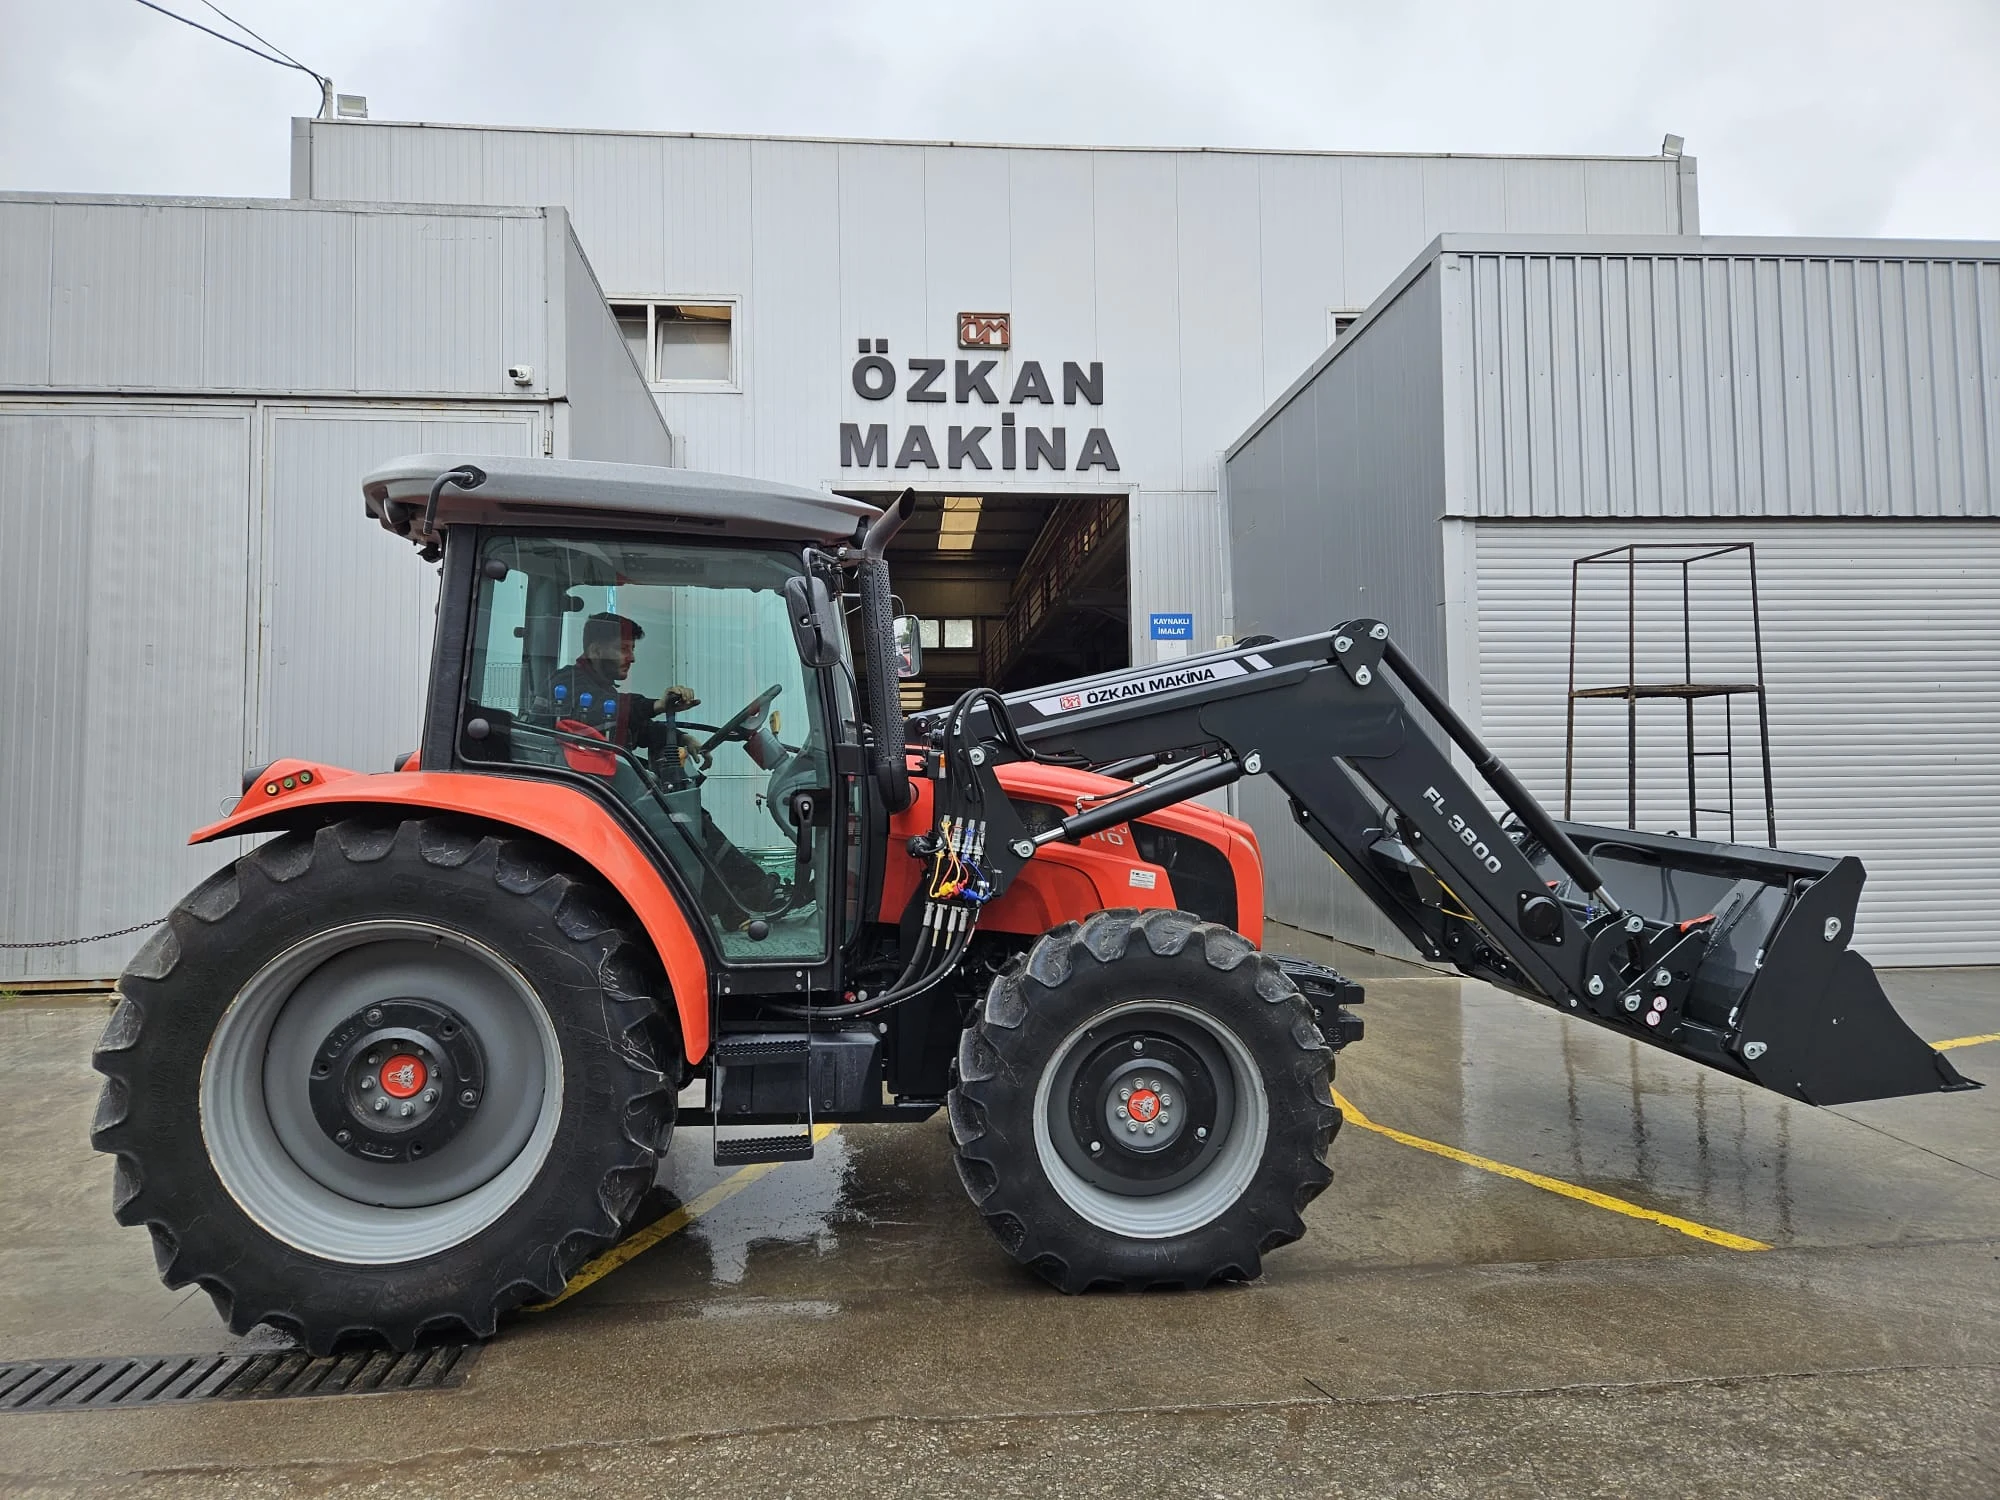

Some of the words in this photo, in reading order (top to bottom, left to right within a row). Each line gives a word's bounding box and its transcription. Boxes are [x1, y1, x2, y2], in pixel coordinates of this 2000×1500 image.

[852, 338, 1103, 405] ÖZKAN
[840, 412, 1120, 471] MAKİNA
[1157, 626, 1186, 635] İMALAT
[1086, 681, 1145, 705] ÖZKAN
[1149, 668, 1216, 692] MAKİNA
[1422, 786, 1446, 816] FL
[1447, 814, 1502, 874] 3800
